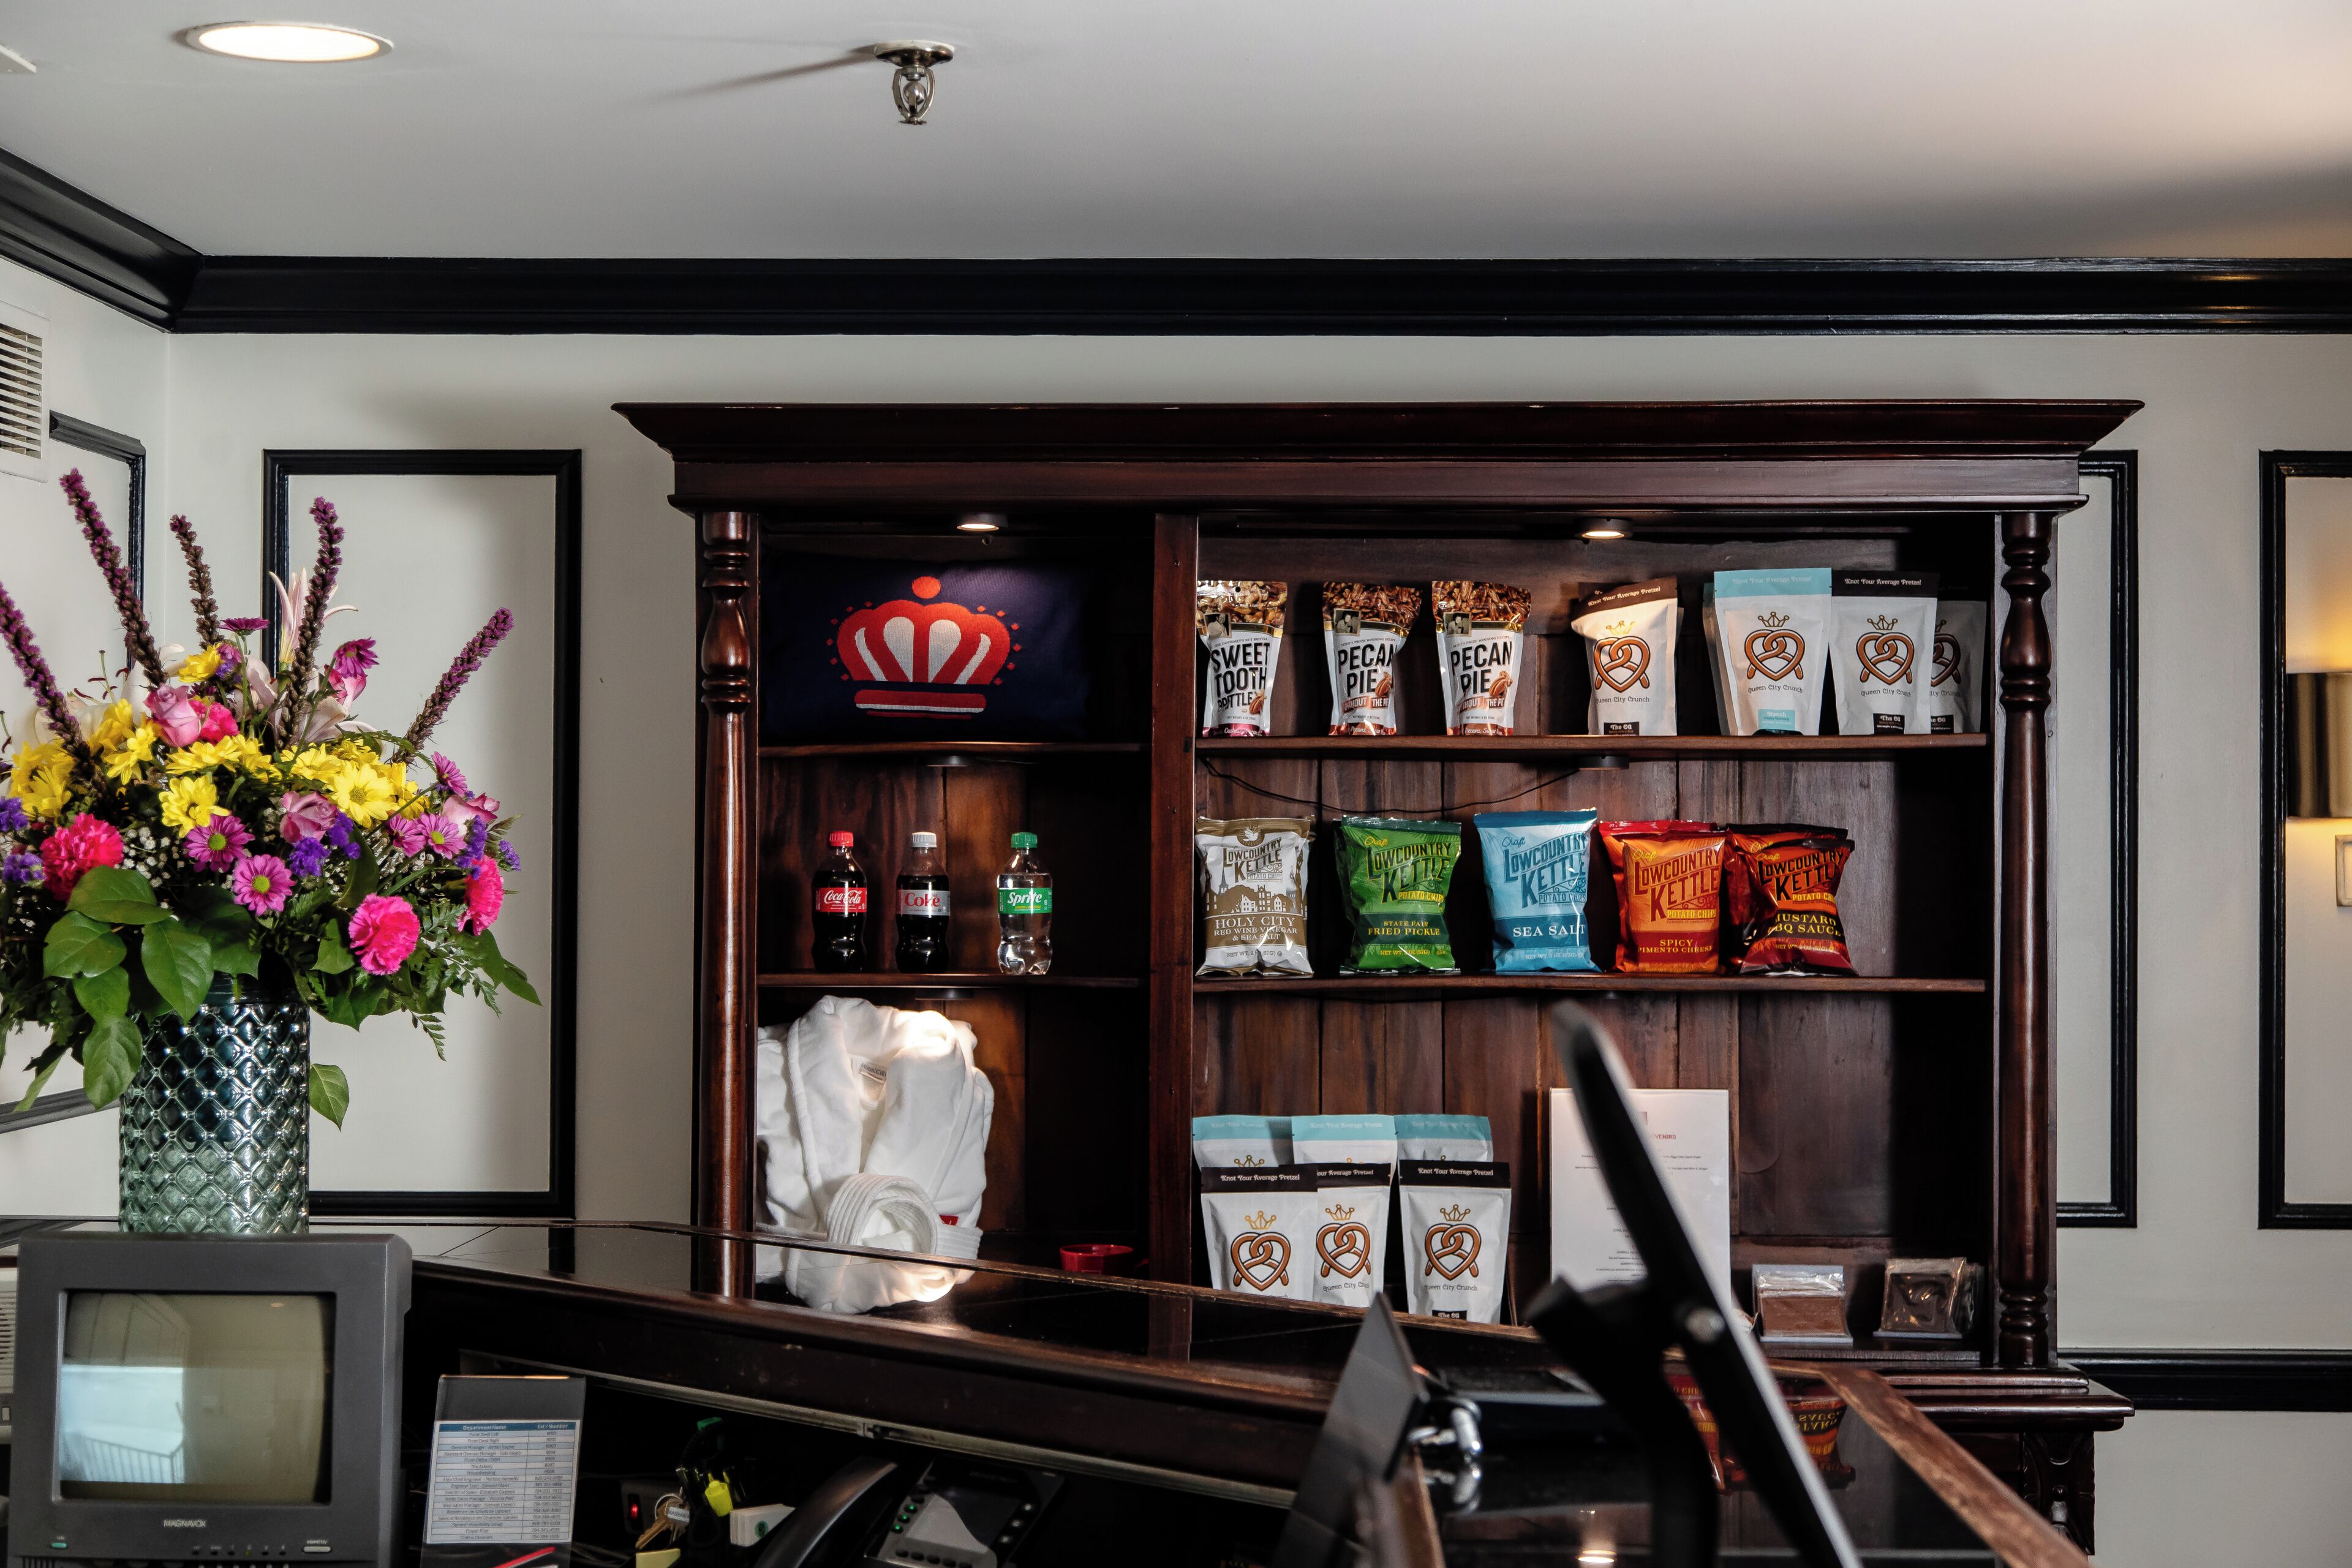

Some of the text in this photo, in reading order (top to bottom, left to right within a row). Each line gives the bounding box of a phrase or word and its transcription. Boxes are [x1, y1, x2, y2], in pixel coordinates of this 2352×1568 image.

[1617, 590, 1639, 598] Average
[1211, 643, 1270, 673] SWEET
[1338, 643, 1398, 673] PECAN
[1451, 641, 1512, 676] PECAN
[1215, 667, 1267, 698] TOOTH
[1347, 669, 1378, 697] PIE
[1460, 669, 1491, 696] PIE
[1783, 685, 1803, 693] Crunch
[1373, 698, 1382, 706] THE
[1223, 837, 1282, 867] LOWCOUNTRY
[1502, 836, 1526, 848] Craft
[1235, 849, 1283, 883] KETTLE
[1366, 843, 1451, 881] LOWCOUNTRY
[1503, 832, 1587, 883] LOWCOUNTRY
[1758, 850, 1844, 887] LOWCOUNTRY
[1382, 858, 1450, 903] KETTLE
[1521, 850, 1586, 908] KETTLE
[1634, 848, 1721, 895] LOWCOUNTRY
[905, 892, 941, 907] Coke
[1008, 892, 1042, 906] Sprite
[1398, 891, 1425, 900] POTATO
[1539, 894, 1566, 902] POTATO
[1651, 867, 1720, 922] KETTLE
[1792, 892, 1821, 902] POTATO
[1215, 916, 1295, 929] HOLY CITY
[1513, 924, 1585, 937] SEA SALT
[1798, 924, 1841, 937] SAUCE
[163, 1519, 206, 1528] MAGNAVOX
